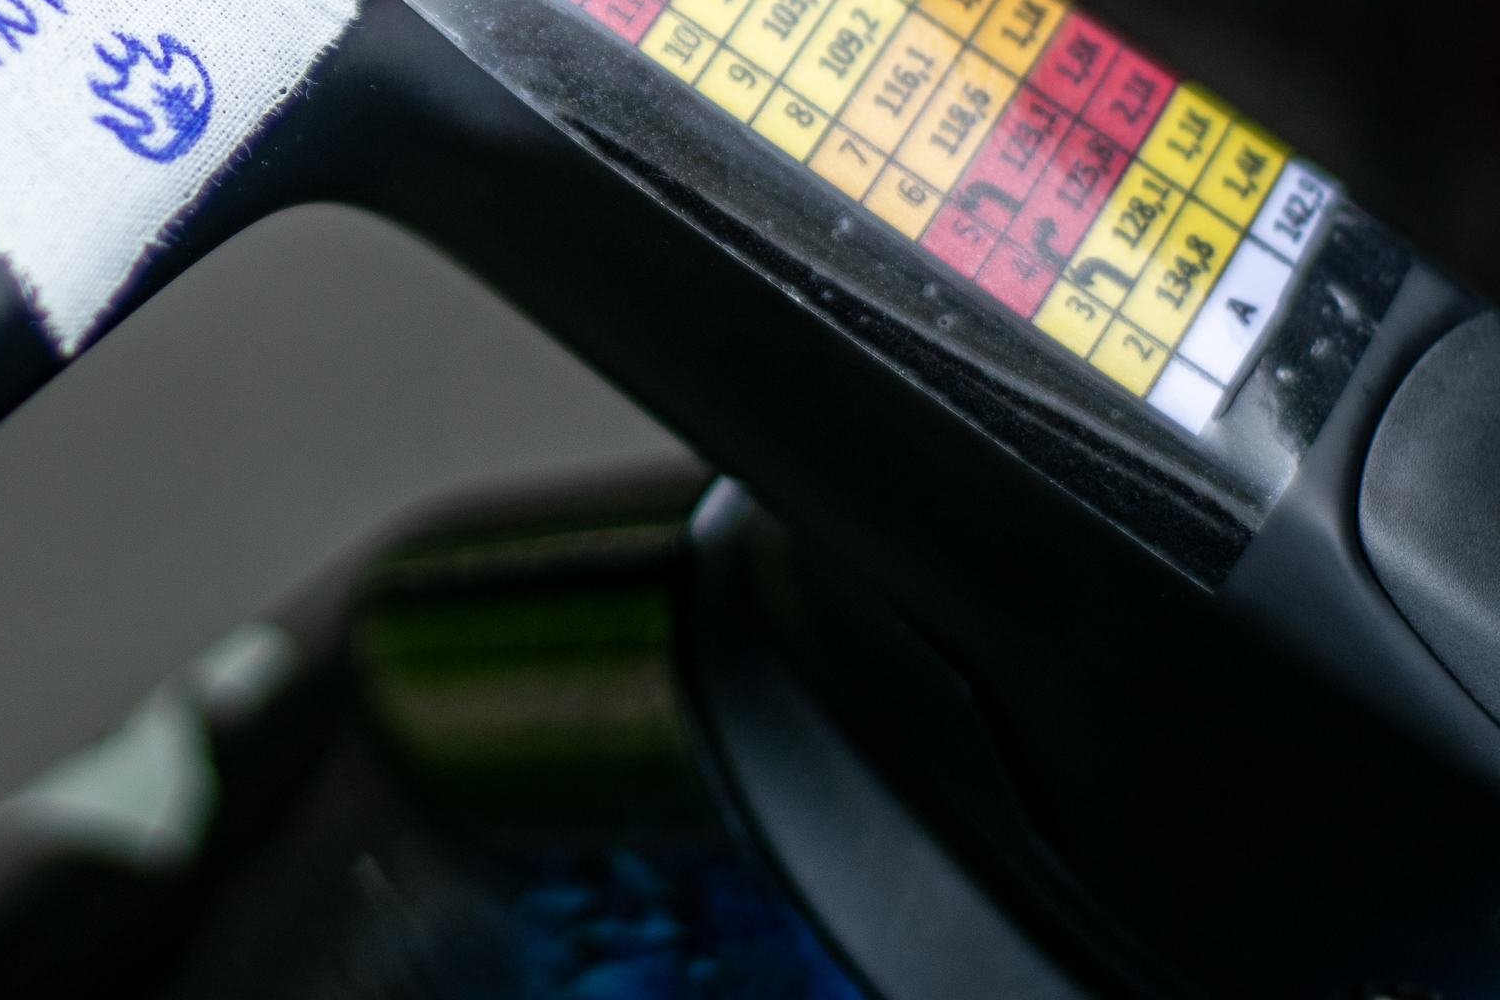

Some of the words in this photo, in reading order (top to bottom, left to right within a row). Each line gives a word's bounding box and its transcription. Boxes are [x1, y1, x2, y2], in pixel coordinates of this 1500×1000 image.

[663, 24, 701, 64] 10
[728, 63, 756, 88] 9
[784, 101, 814, 127] 8
[819, 8, 878, 78] 109,2
[897, 179, 926, 205] 6
[930, 84, 990, 155] 118,6
[1001, 0, 1047, 48] 1,1K
[838, 138, 867, 165] 7
[874, 47, 933, 116] 116,1
[951, 217, 982, 245] 5
[1001, 103, 1057, 170] 123,1
[1010, 254, 1038, 282] 4
[1110, 74, 1156, 124] 2,1K
[1065, 295, 1095, 320] 3
[1113, 179, 1170, 248] 128,1
[1167, 110, 1211, 160] 1,1K
[1122, 334, 1154, 361] 2
[1157, 235, 1214, 307] 134,8
[1226, 298, 1256, 324] A
